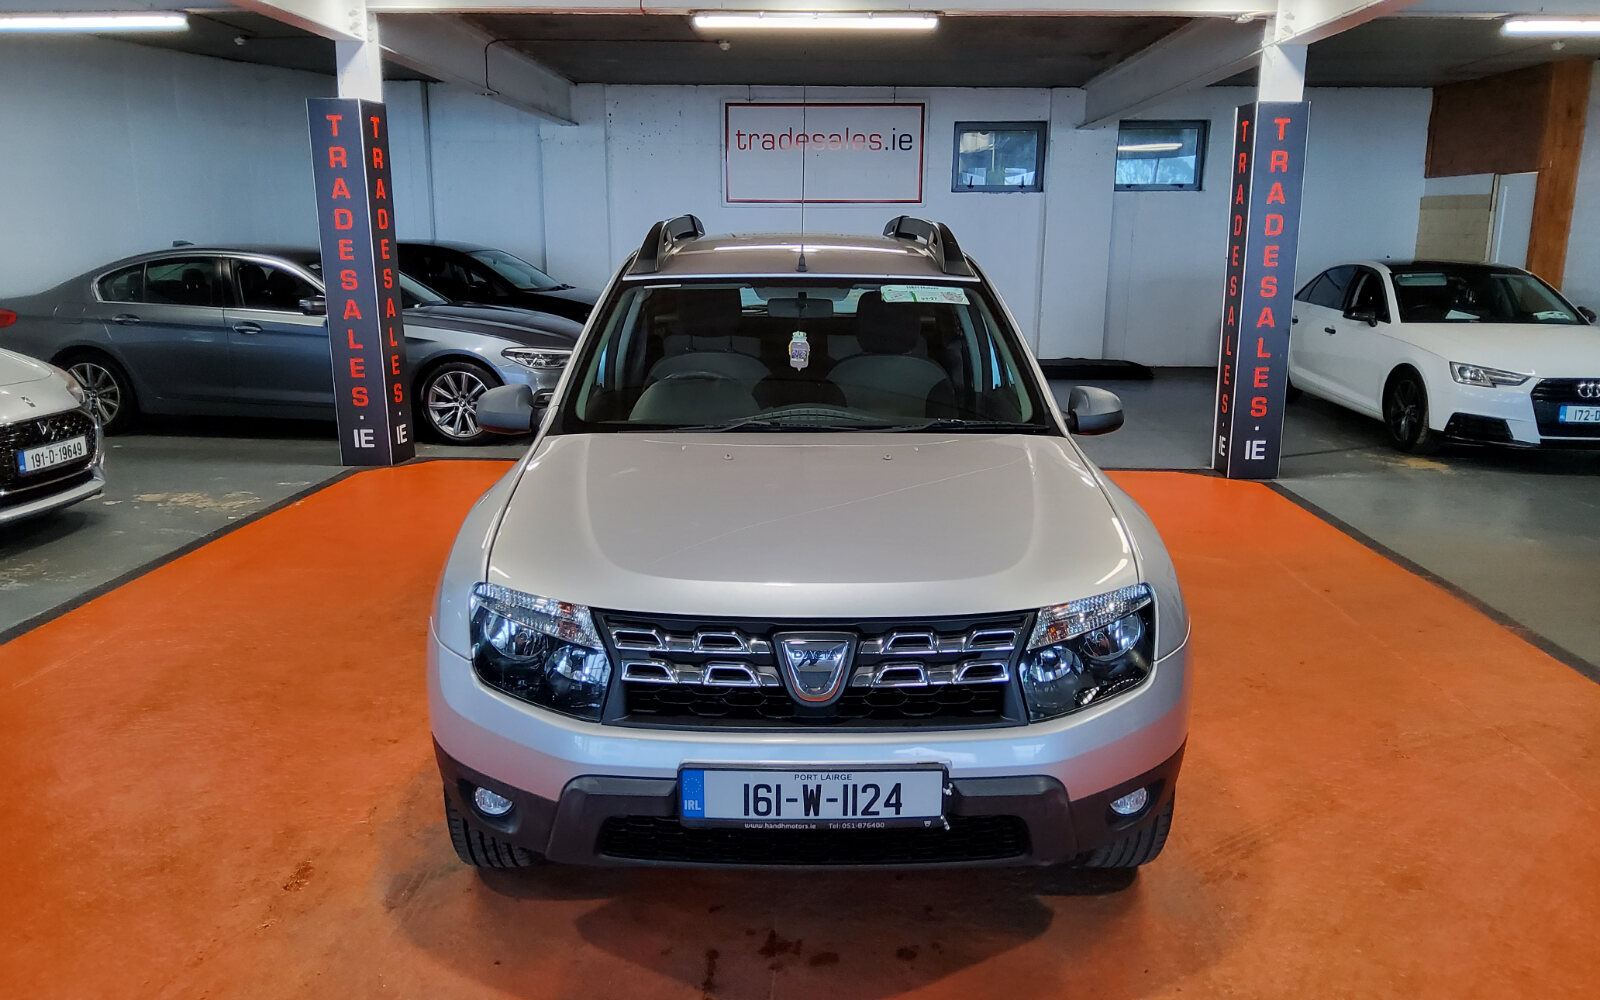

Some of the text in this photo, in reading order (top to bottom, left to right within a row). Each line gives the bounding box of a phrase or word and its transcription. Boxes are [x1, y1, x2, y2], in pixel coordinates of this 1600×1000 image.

[735, 127, 913, 151] tradesales.ie
[31, 441, 83, 469] 191-D-19649
[794, 773, 818, 781] PORT
[684, 799, 702, 811] IRL
[743, 782, 903, 817] 161-W-1124
[744, 822, 817, 830] www.handhmotors.ie
[828, 822, 840, 830] Tel:
